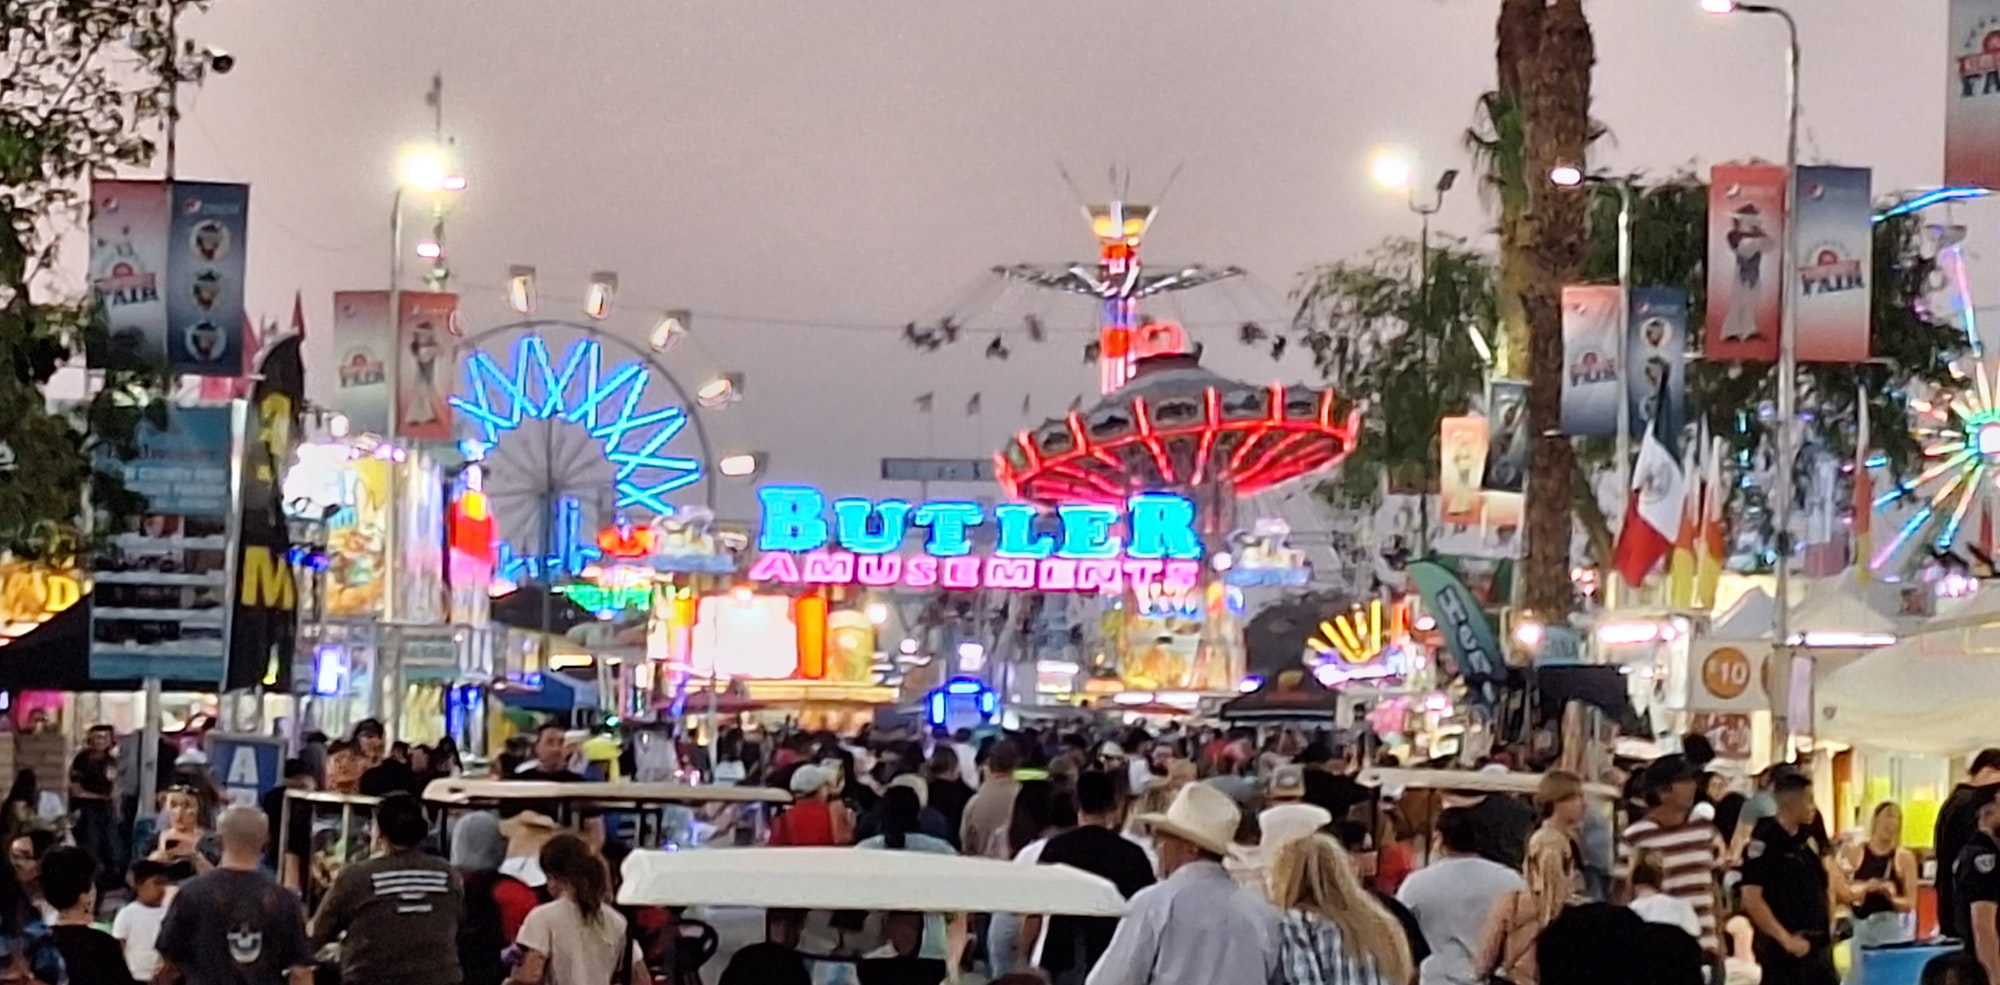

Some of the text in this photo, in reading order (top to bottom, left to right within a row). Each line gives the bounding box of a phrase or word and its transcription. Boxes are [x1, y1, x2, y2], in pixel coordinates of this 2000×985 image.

[1802, 268, 1865, 297] FAIR
[757, 484, 1206, 560] BUTLER
[748, 551, 1200, 594] AMUSEMENTS
[227, 746, 260, 785] A
